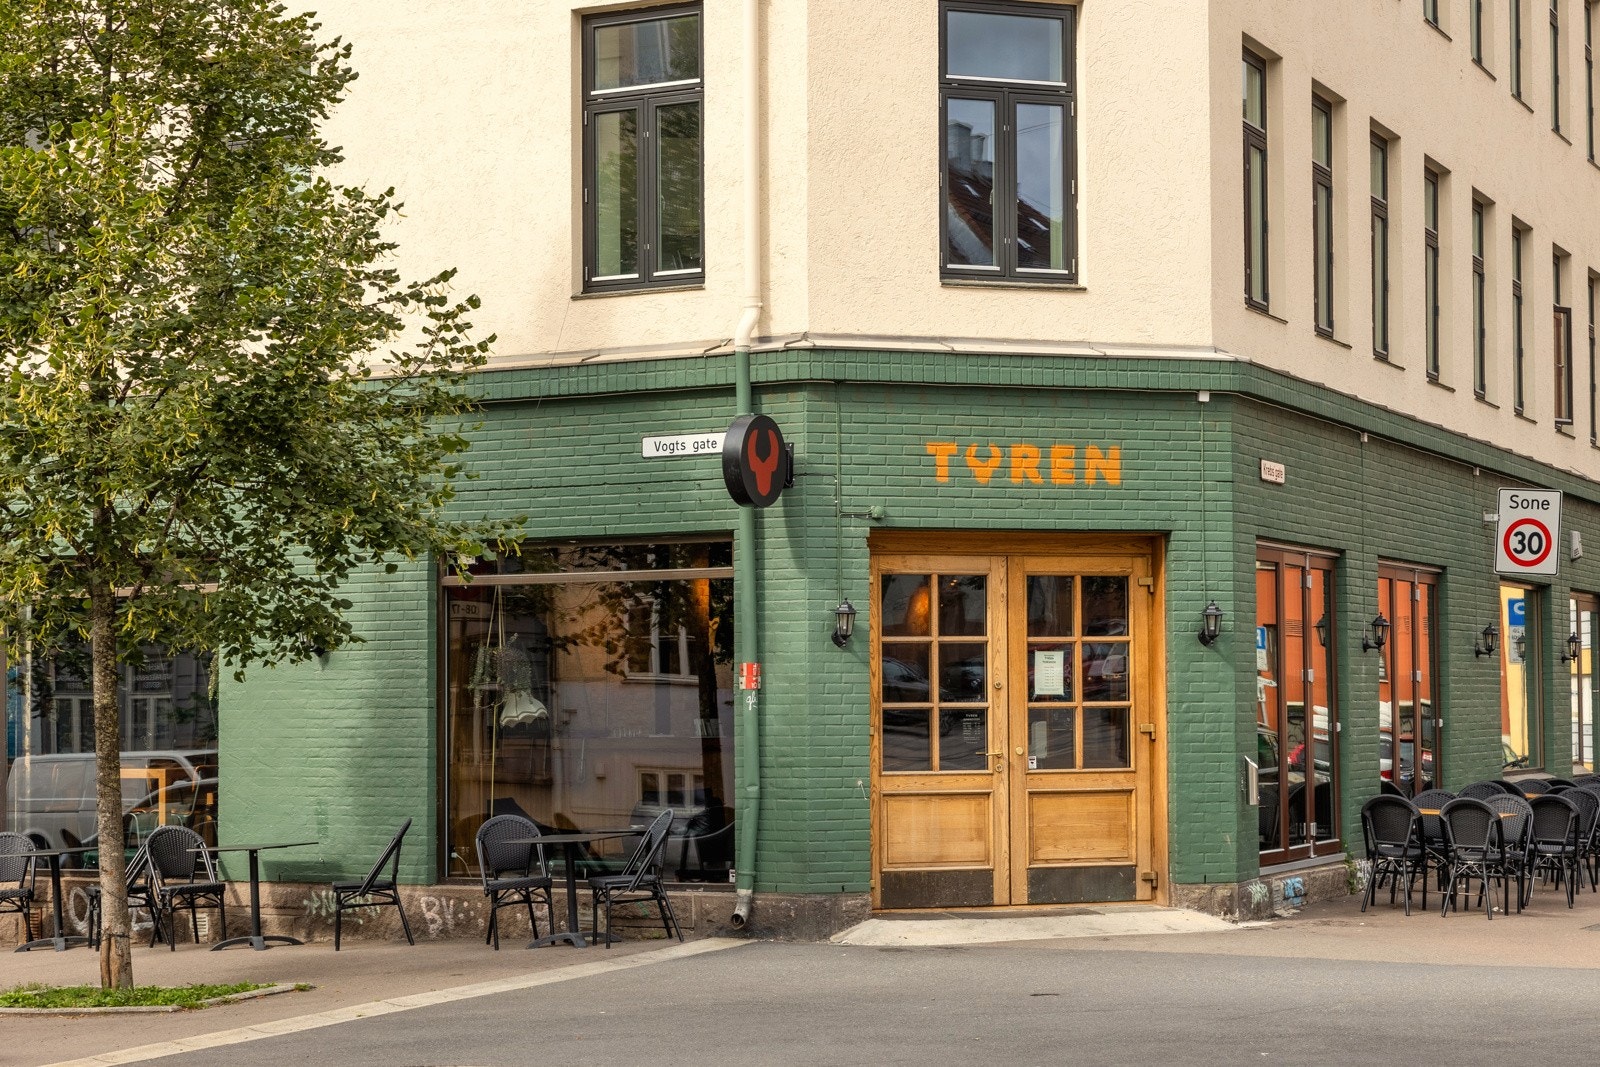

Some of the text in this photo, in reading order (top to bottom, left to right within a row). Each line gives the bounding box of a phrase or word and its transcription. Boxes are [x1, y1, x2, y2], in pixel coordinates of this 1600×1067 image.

[654, 438, 718, 454] Vogts gate
[926, 442, 1122, 485] TYREN
[1509, 494, 1550, 510] Sone
[1512, 530, 1543, 555] 30
